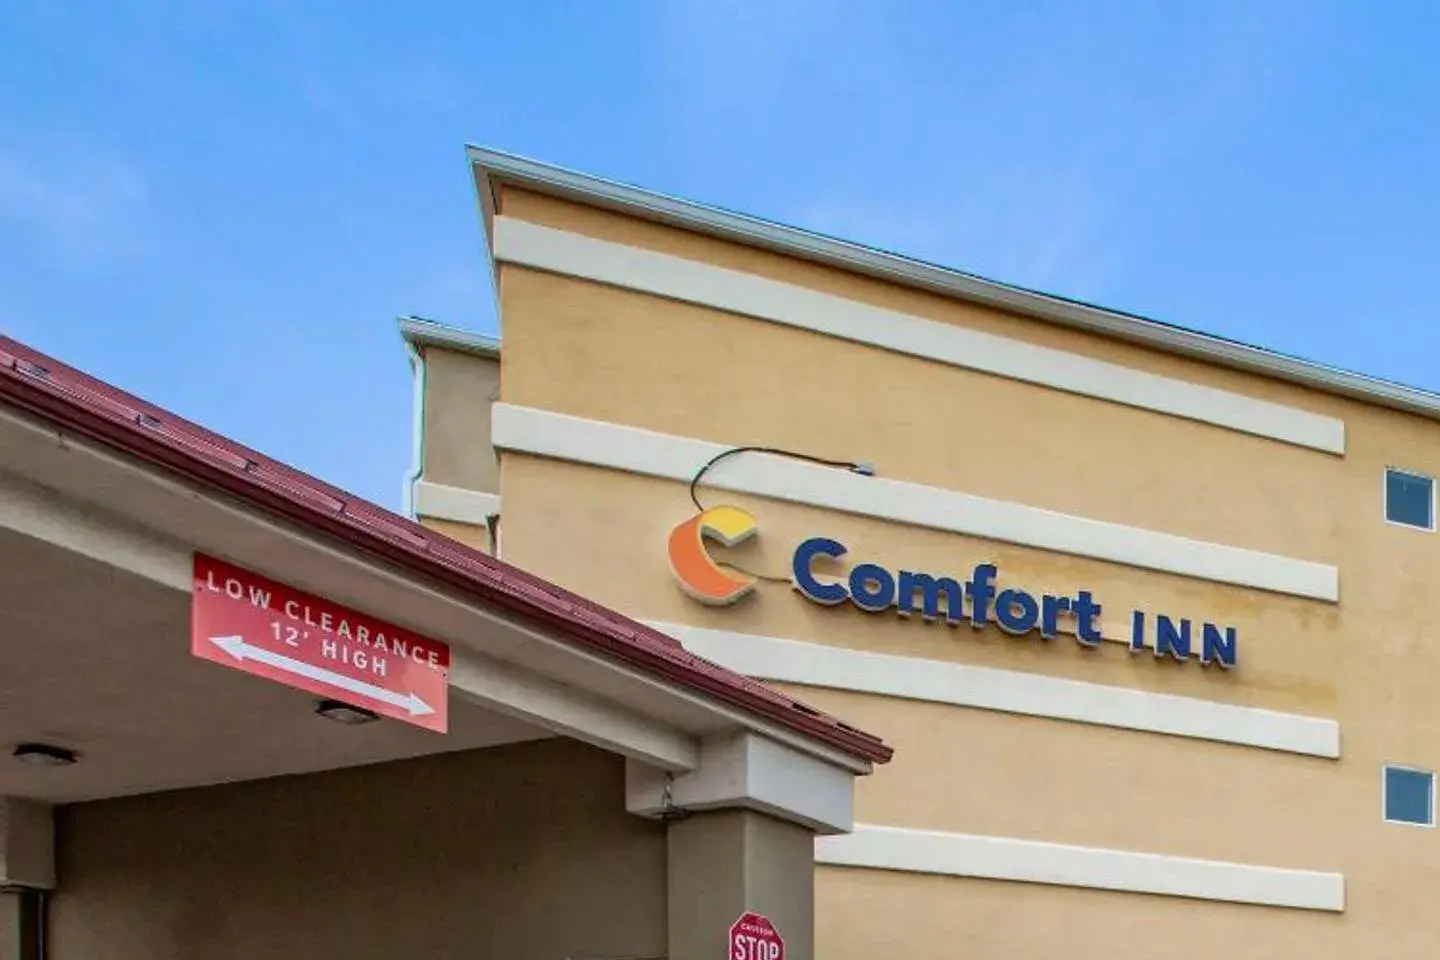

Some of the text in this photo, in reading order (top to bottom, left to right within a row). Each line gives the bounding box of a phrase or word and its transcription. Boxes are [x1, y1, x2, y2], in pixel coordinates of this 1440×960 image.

[207, 570, 441, 670] LOW CLEARANCE
[271, 621, 388, 677] 12' HIGH
[792, 537, 1237, 668] Comfort INN
